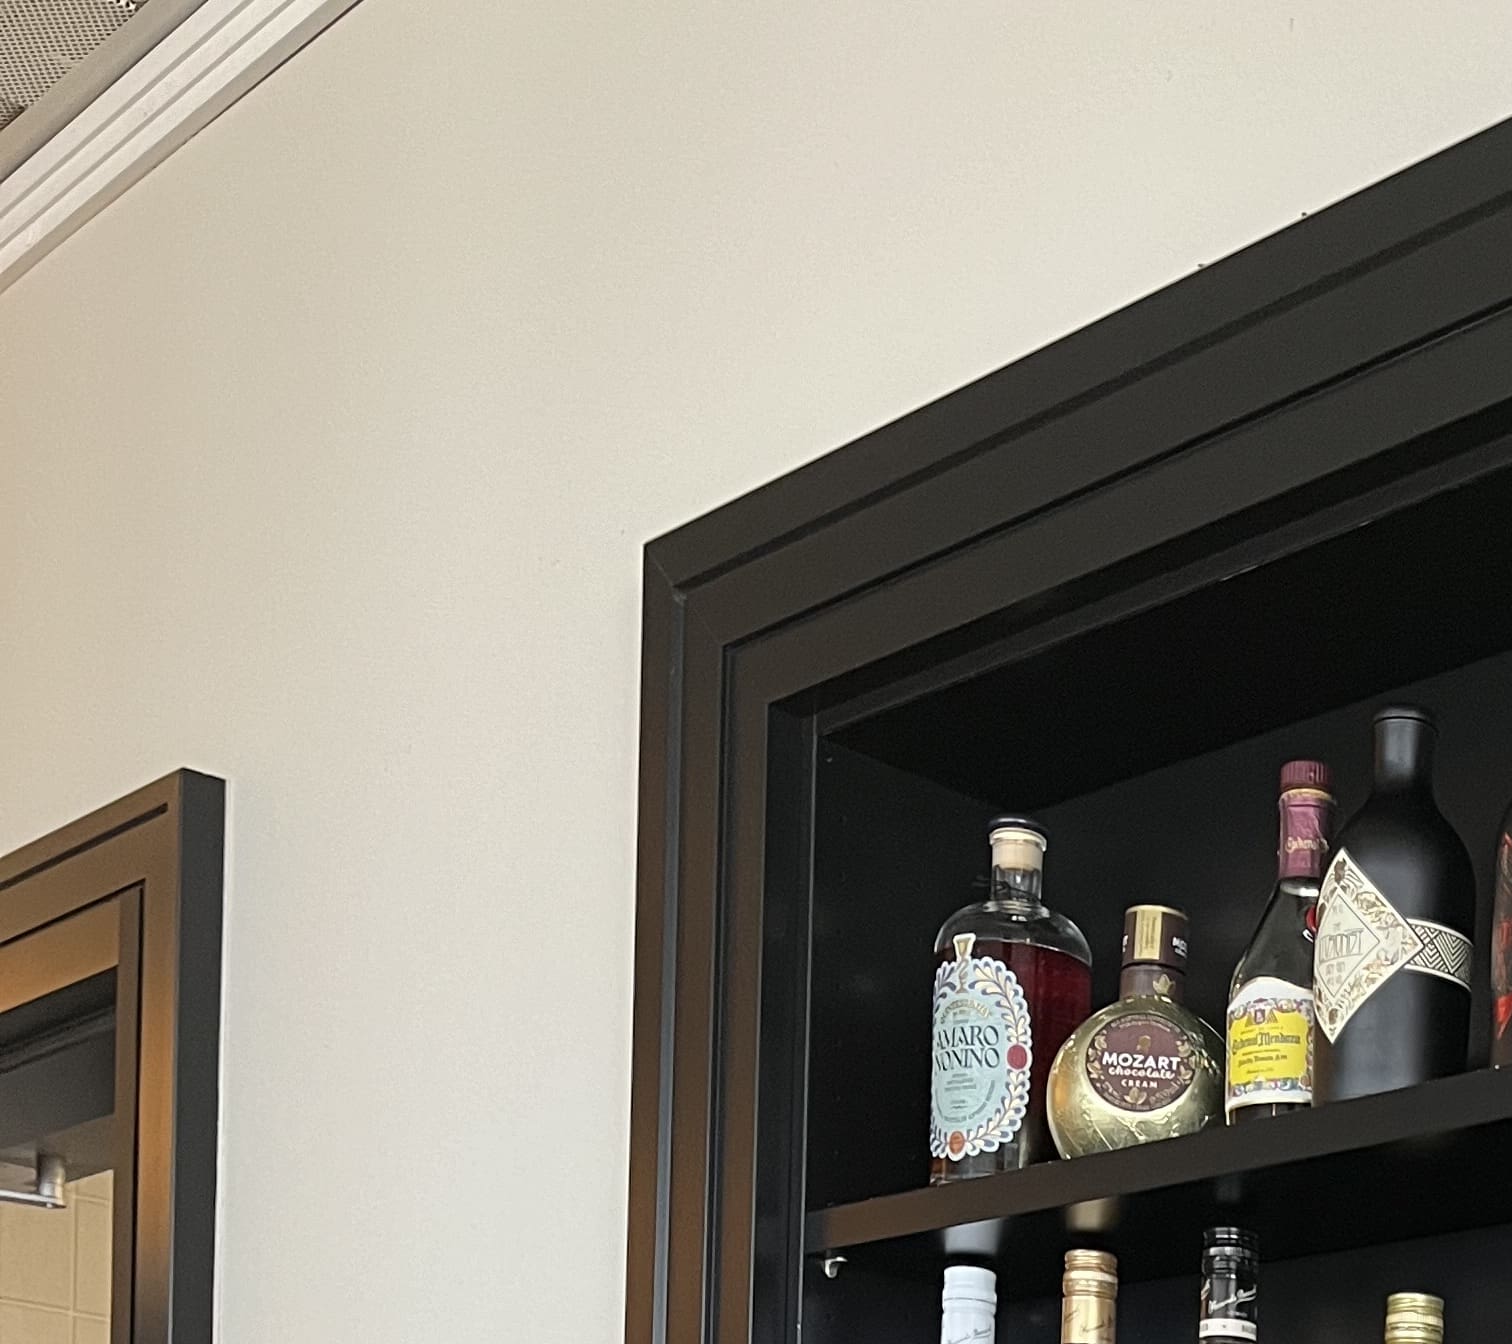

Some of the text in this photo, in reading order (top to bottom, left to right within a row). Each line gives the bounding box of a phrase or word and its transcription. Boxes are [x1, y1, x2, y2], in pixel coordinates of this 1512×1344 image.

[1102, 1051, 1181, 1070] MOZART
[1108, 1065, 1175, 1079] chocolate
[1121, 1079, 1158, 1088] CREAM
